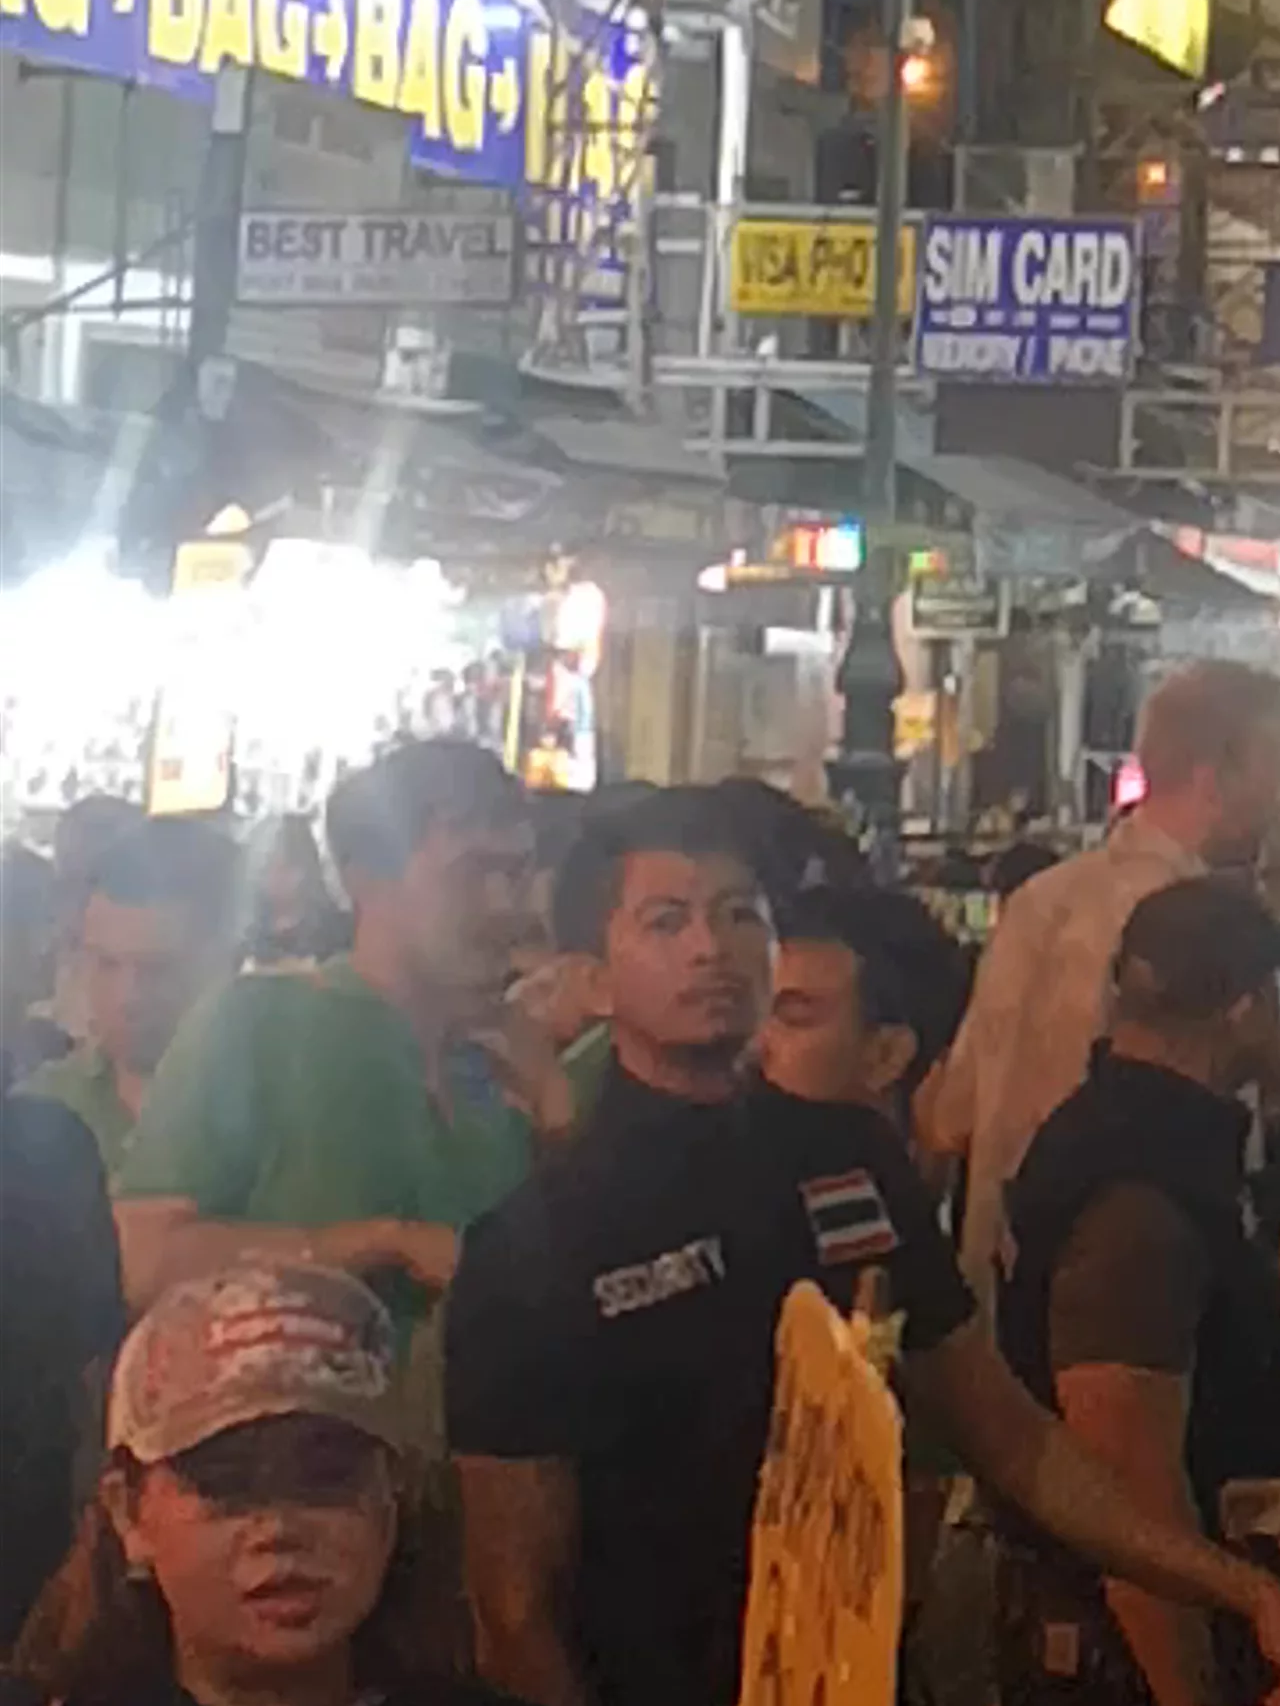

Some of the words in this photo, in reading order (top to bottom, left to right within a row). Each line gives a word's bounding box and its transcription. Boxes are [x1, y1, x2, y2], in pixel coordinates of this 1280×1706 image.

[247, 220, 347, 263] BEST
[359, 219, 510, 263] TRAVEL
[740, 236, 798, 287] VISA
[808, 235, 902, 289] PHO
[926, 226, 1003, 304] SIM
[1012, 230, 1131, 308] CARD
[592, 1234, 727, 1318] SECURITY
